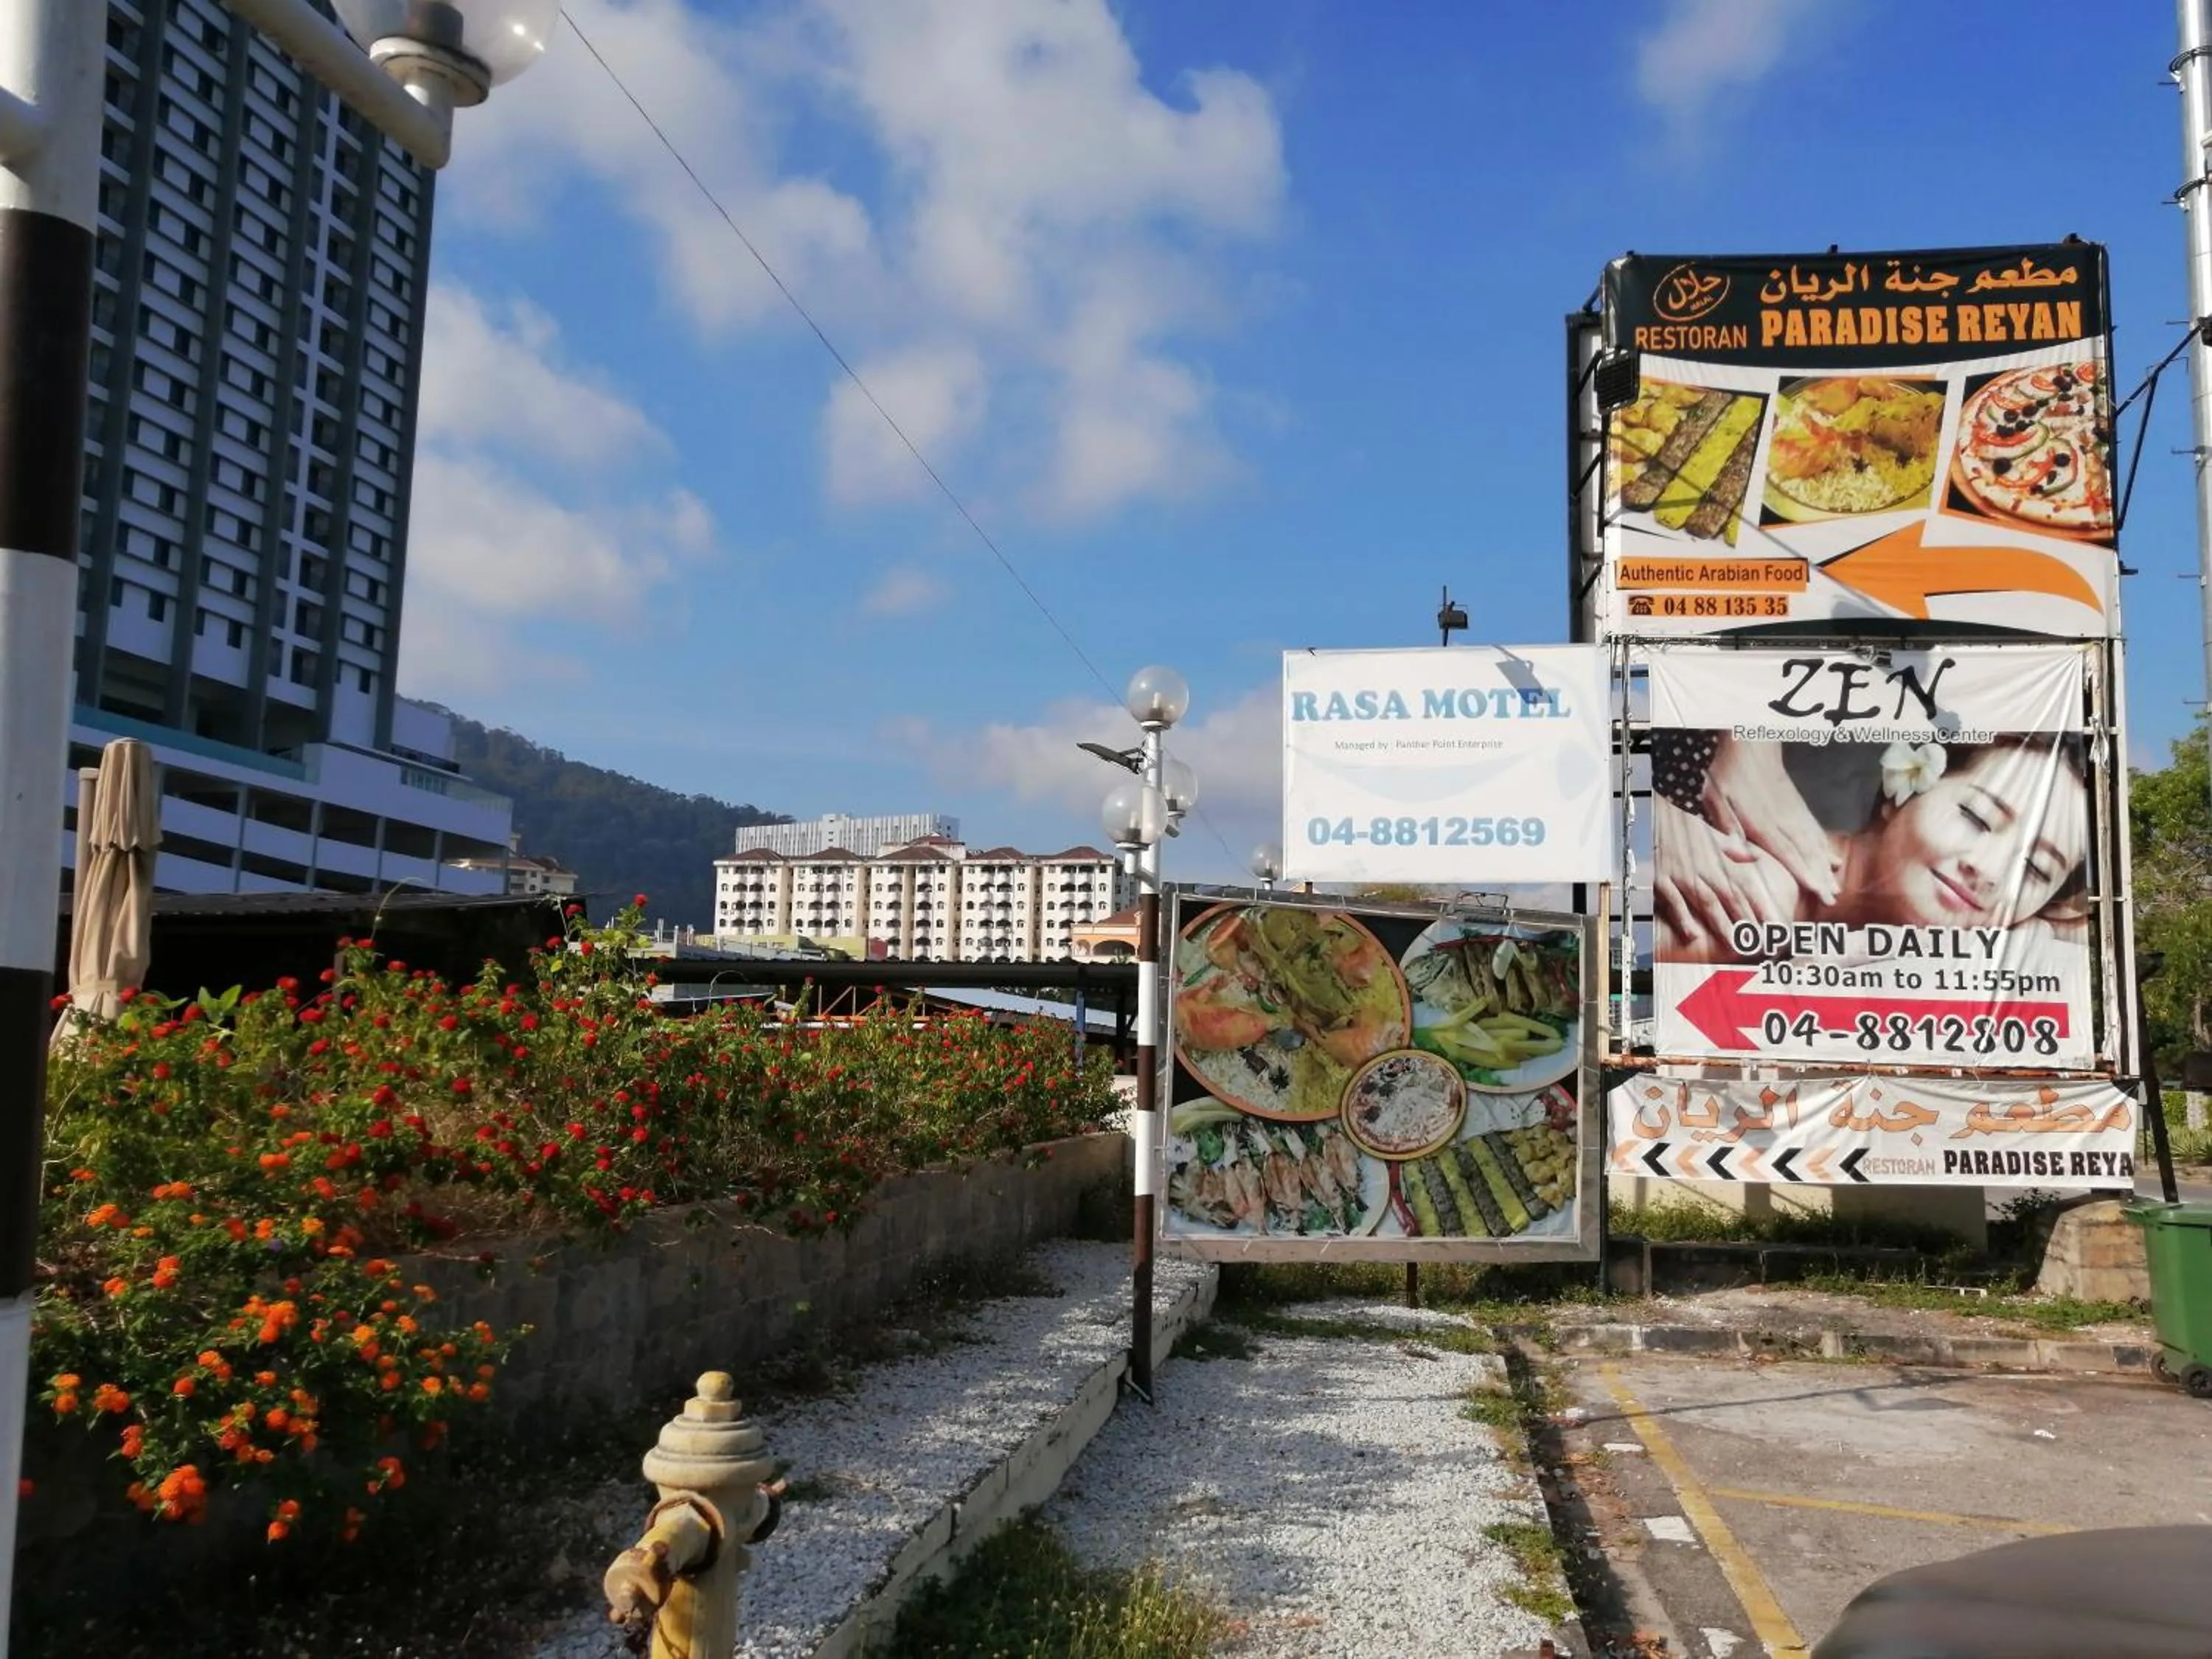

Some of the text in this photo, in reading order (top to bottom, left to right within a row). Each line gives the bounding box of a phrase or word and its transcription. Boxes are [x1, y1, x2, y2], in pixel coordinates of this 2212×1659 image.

[1668, 270, 1722, 310] حلال
[1760, 257, 2079, 304] مطعم جنة الريان
[1635, 324, 1747, 350] RESTORAN
[1760, 301, 2082, 347] PARADISE REYAN
[1620, 563, 1804, 581] Authentic Arabian Food
[1663, 597, 1788, 615] 04 88 135 35
[1291, 687, 1571, 721] RASA MOTEL
[1768, 657, 1956, 727] ZEN
[1335, 740, 1375, 751] Managed
[1458, 739, 1504, 749] Enterprise
[1733, 725, 1994, 743] Reflexology & Wellness Center
[1307, 816, 1546, 847] 04-8812569
[1733, 922, 2002, 959] OPEN DAILY
[1760, 964, 2061, 997] 10:30am to 11:55pm
[1764, 1012, 2059, 1057] 04-8812808
[1632, 1081, 1798, 1143] الريان
[1949, 1083, 2132, 1139] مطعم
[1863, 1158, 1935, 1175] RESTORAN
[1943, 1150, 2065, 1176] PARADISE
